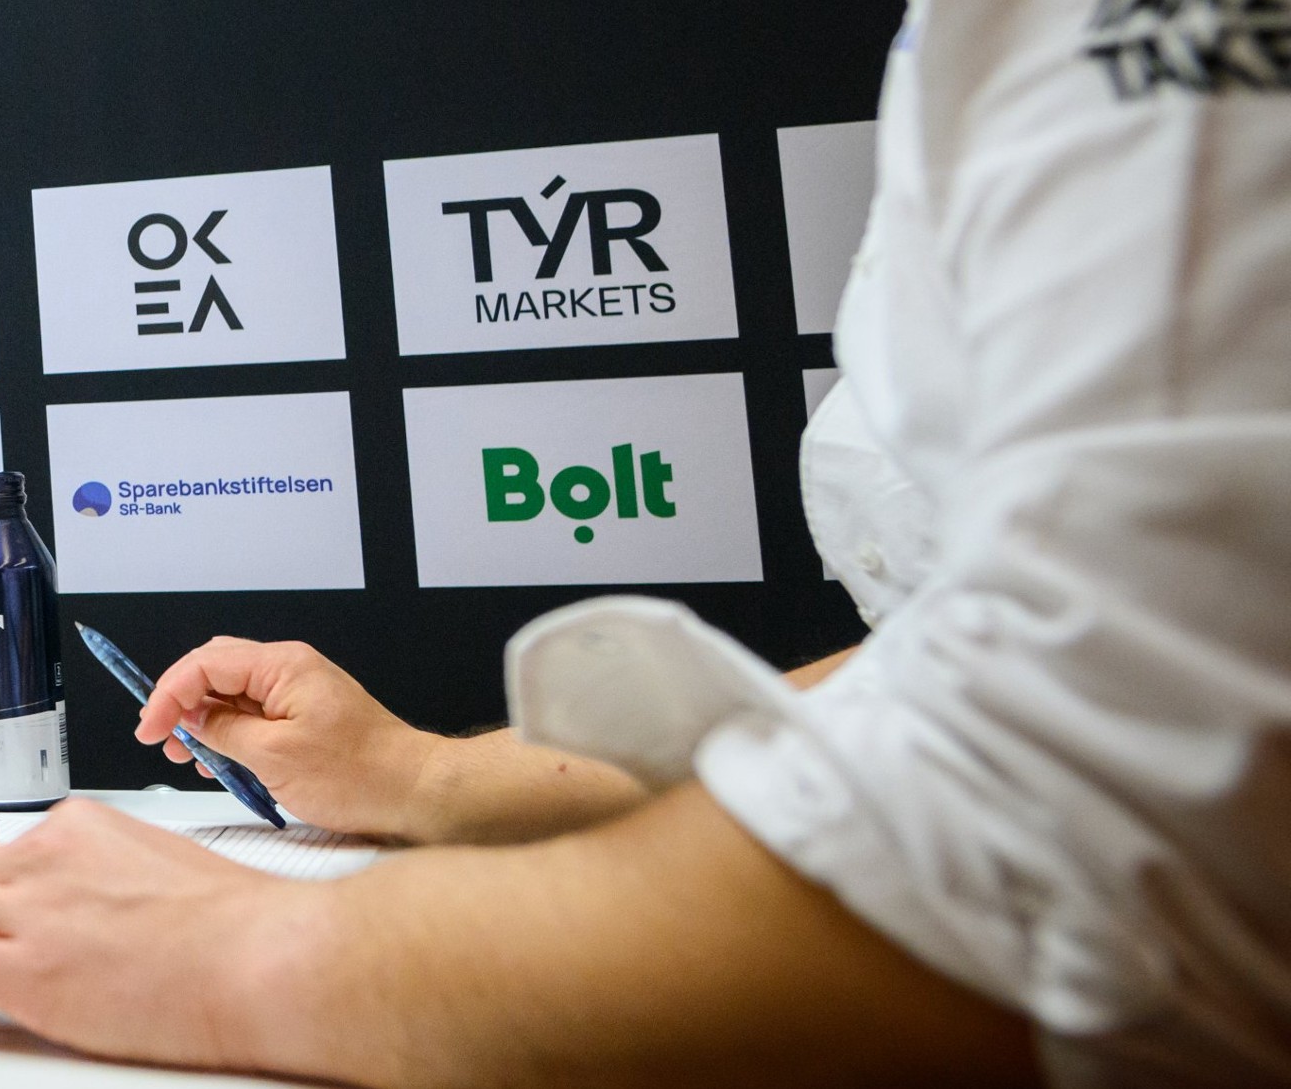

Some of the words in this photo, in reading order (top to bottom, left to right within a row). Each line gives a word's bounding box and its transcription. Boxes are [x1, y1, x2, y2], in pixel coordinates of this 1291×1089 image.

[476, 283, 675, 323] MARKETS
[119, 476, 332, 502] Sparebankstiftelsen
[482, 444, 676, 543] Bolt
[120, 502, 181, 515] SR-Bank
